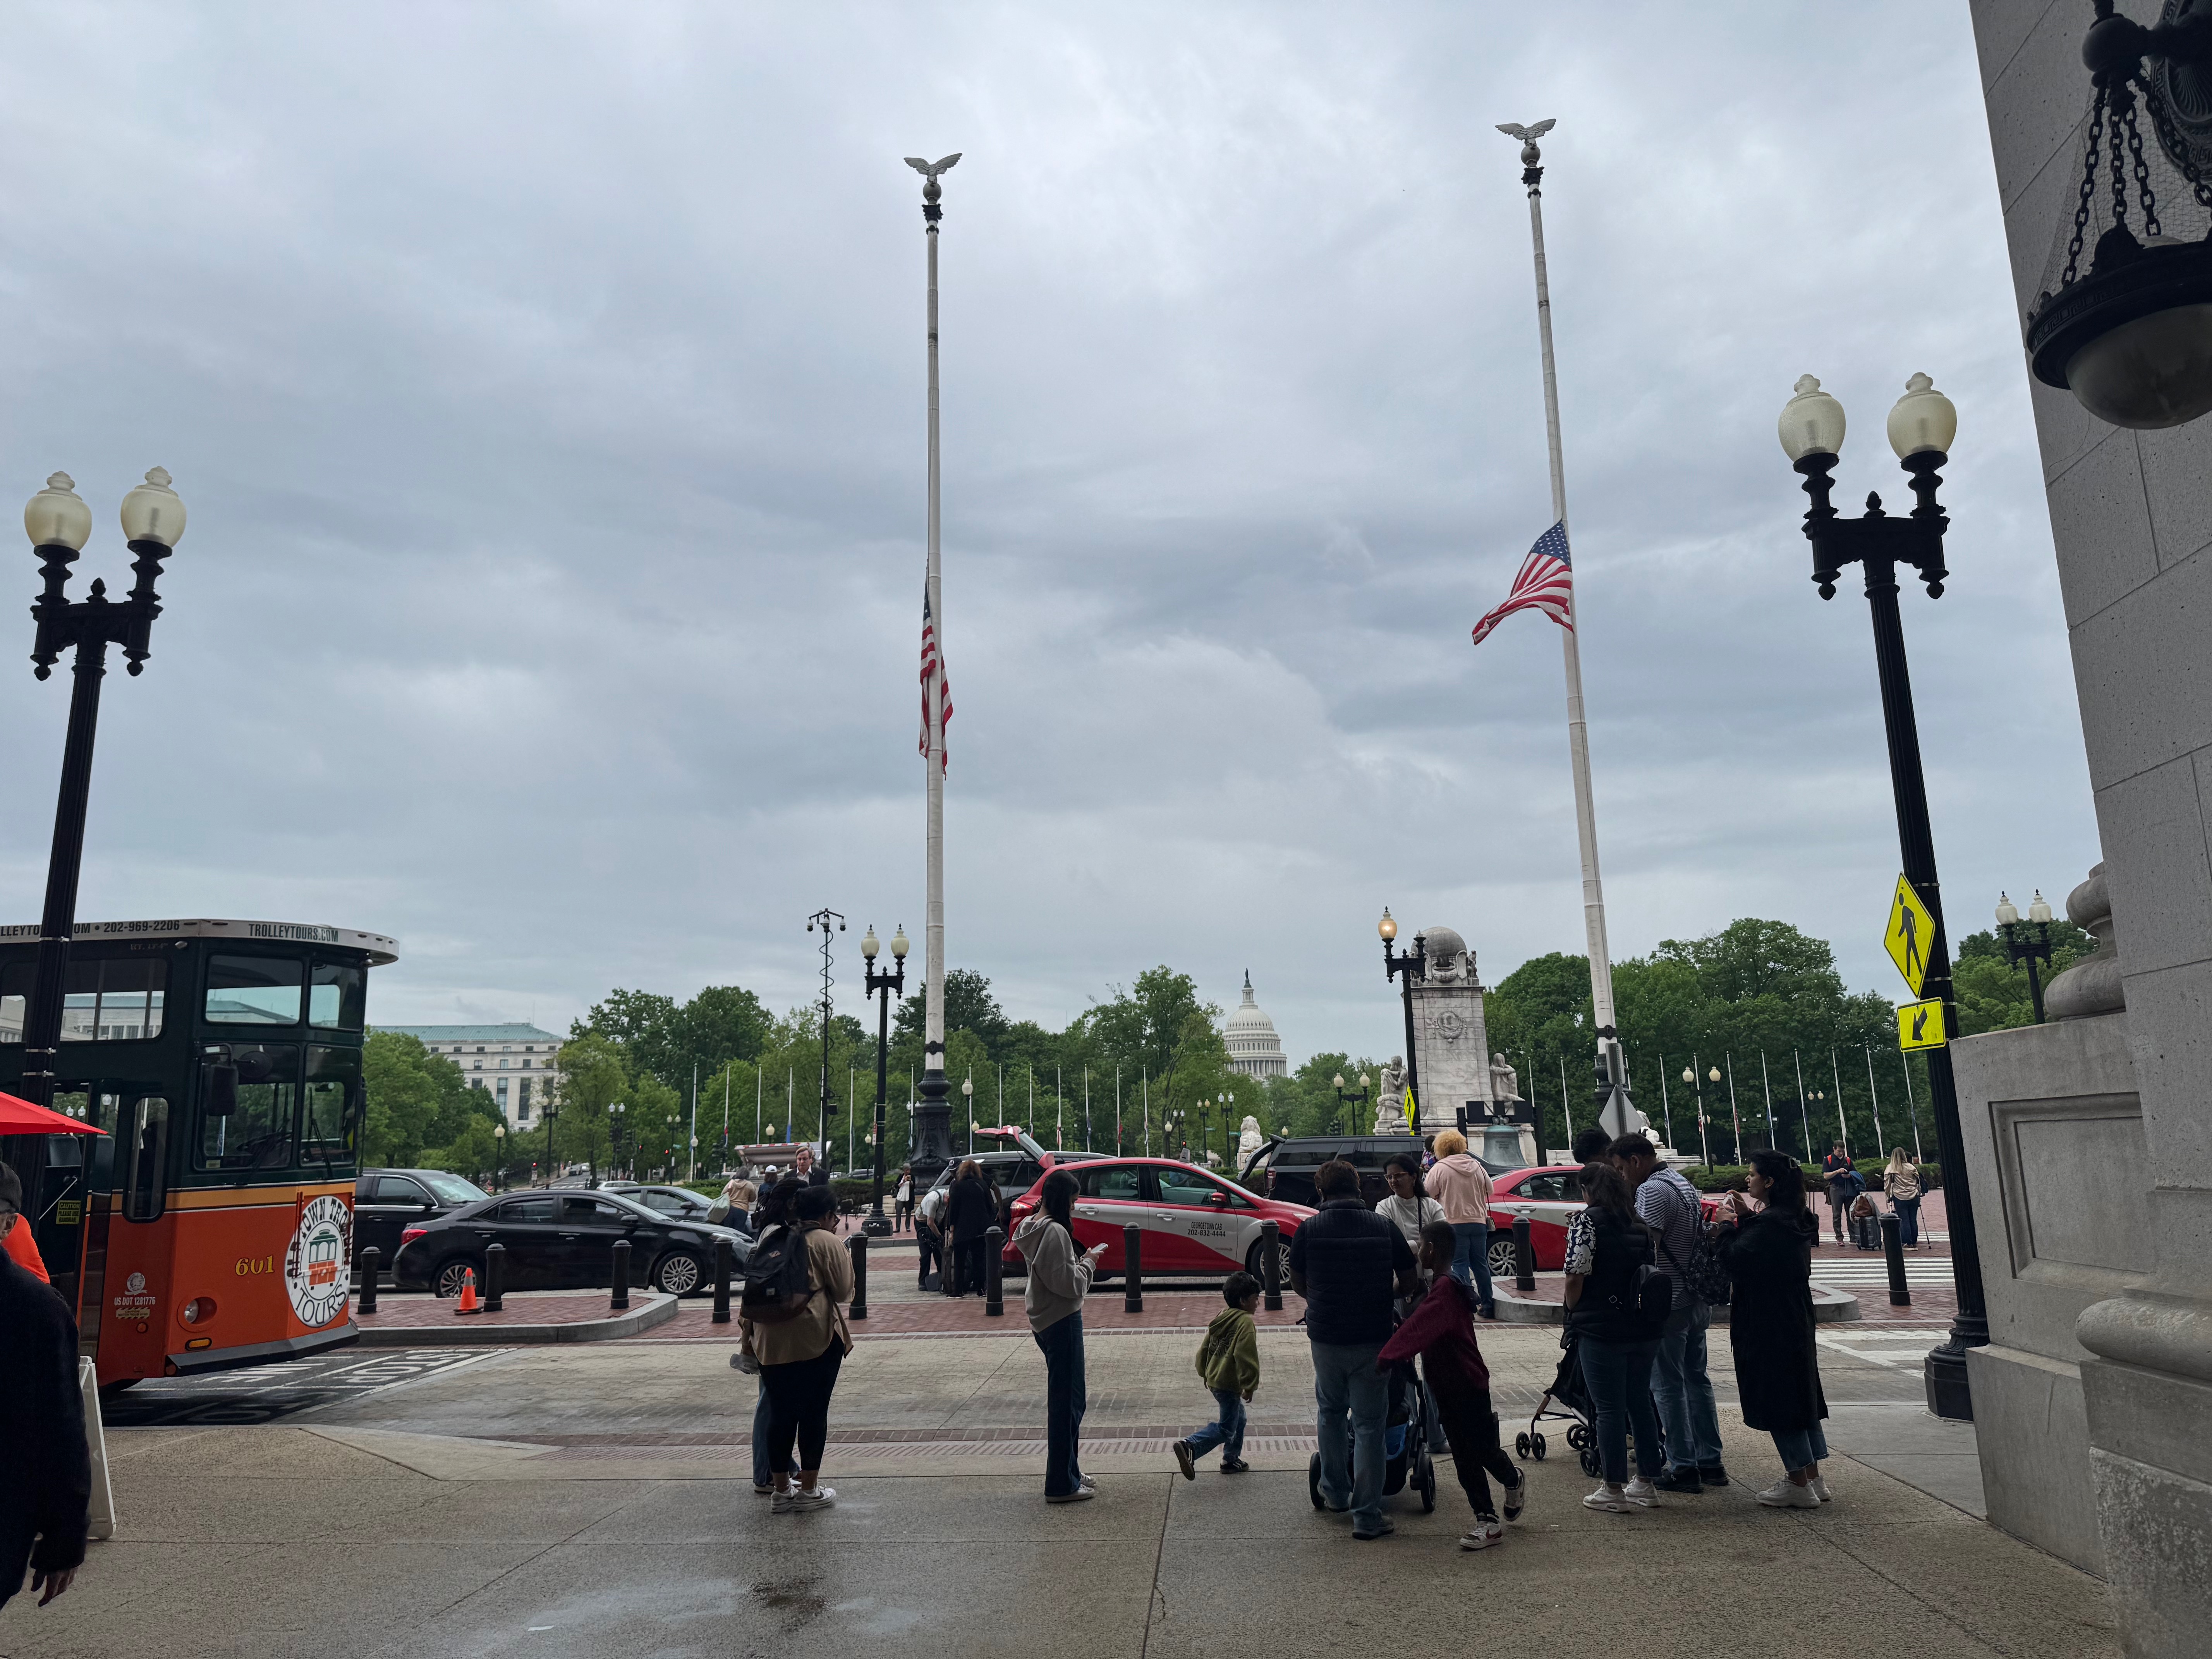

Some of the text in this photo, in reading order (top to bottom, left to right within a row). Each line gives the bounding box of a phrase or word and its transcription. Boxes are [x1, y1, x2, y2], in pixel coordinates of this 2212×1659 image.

[103, 920, 180, 933] 202-969-2206
[249, 924, 338, 942] TROLLEYTOURS.COM
[1191, 1221, 1215, 1230] GEORGETOWN
[1187, 1229, 1226, 1237] 202-832-4444
[235, 1255, 274, 1276] 601
[114, 1297, 122, 1306] US
[122, 1297, 133, 1305] DOT
[295, 1284, 347, 1324] TOURS
